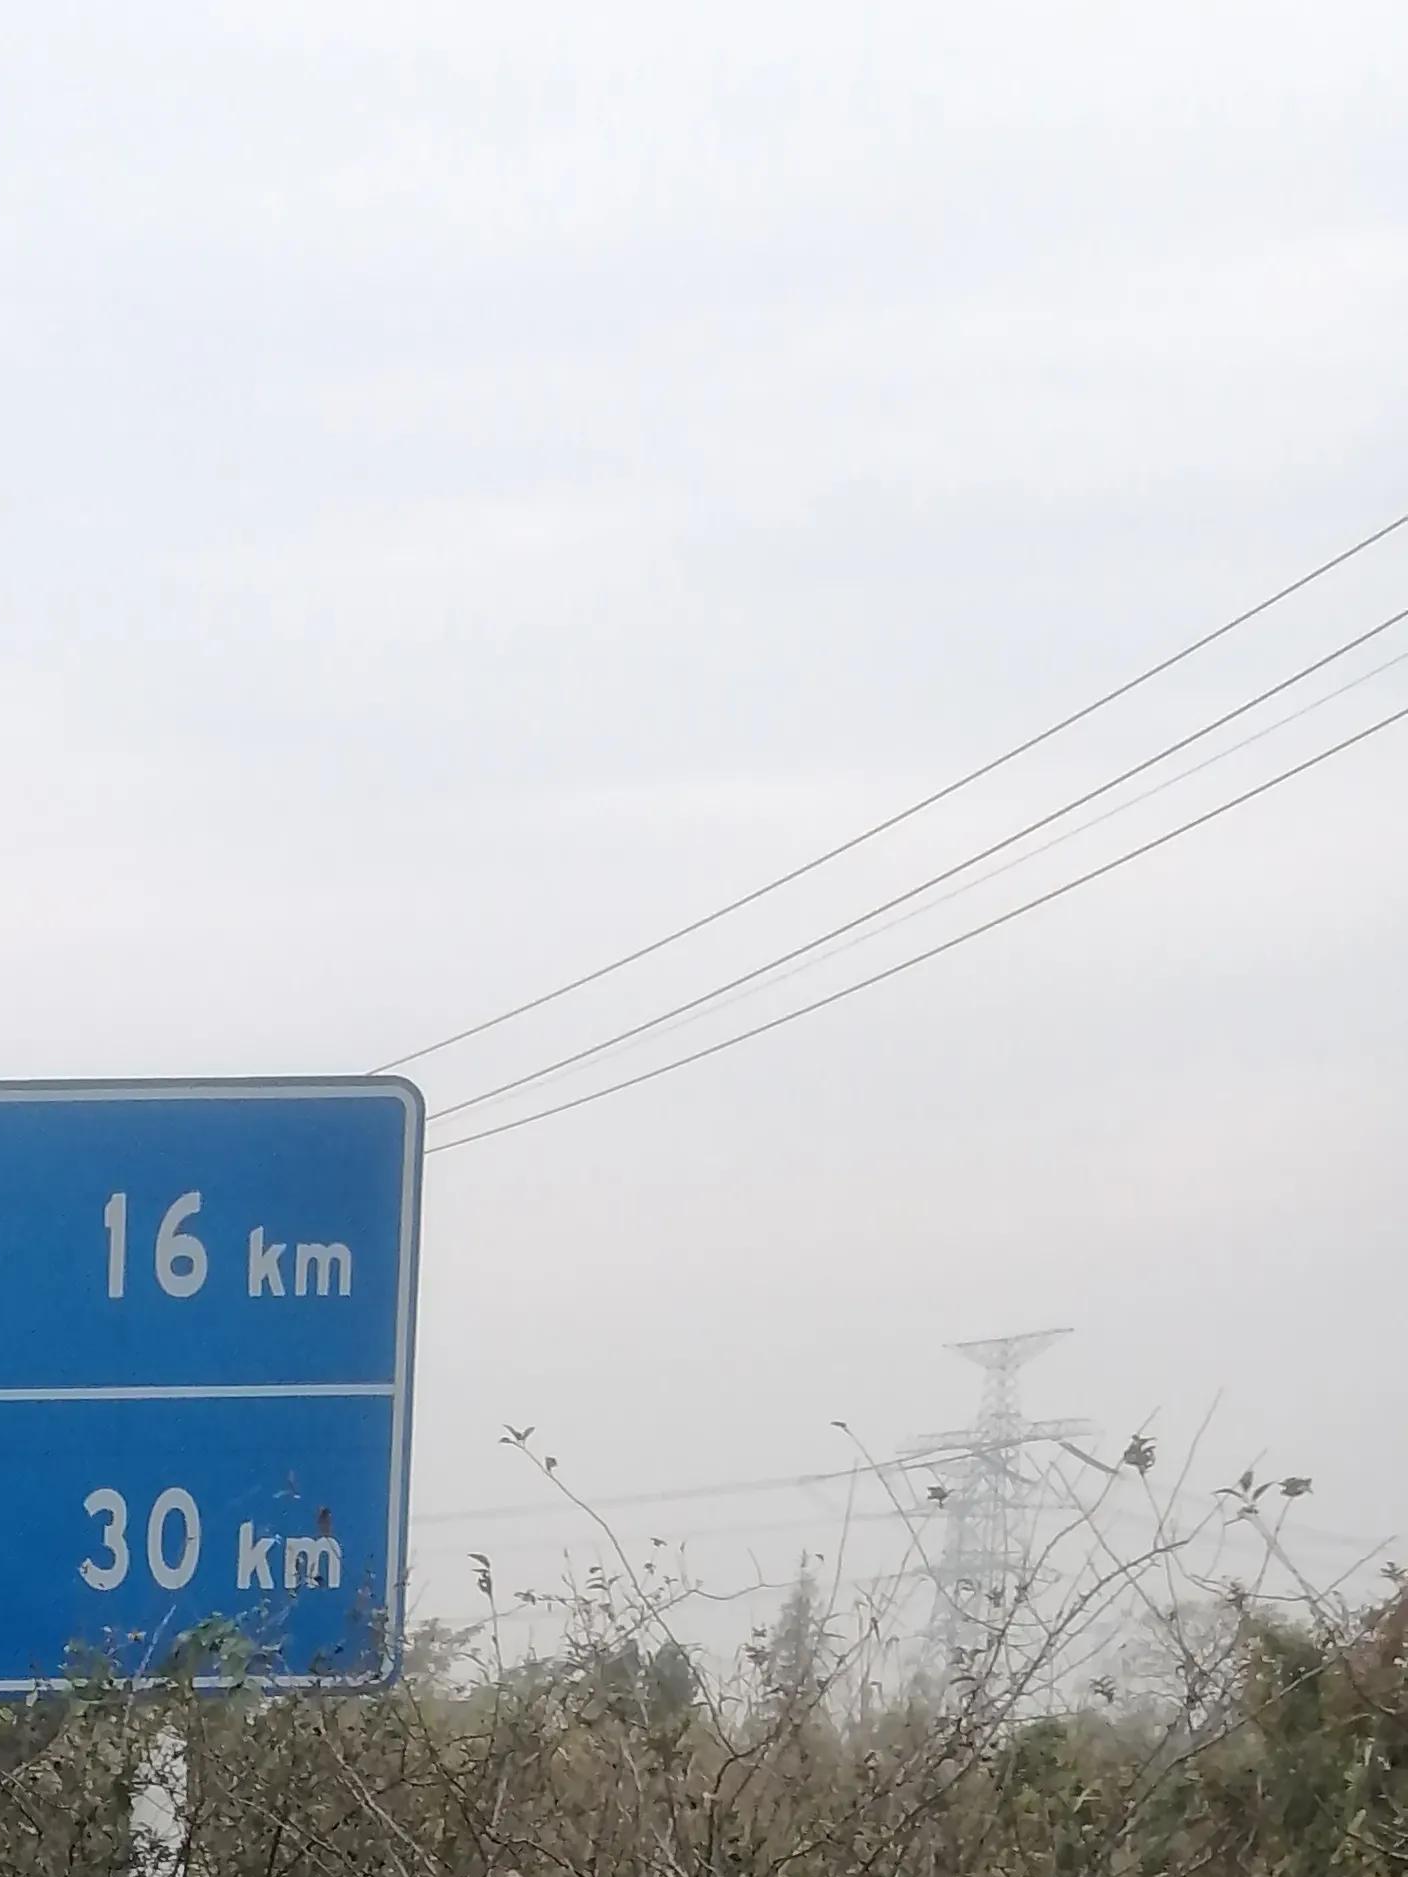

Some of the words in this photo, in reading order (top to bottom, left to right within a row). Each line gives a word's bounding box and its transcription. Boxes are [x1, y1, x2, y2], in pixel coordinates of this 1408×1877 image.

[103, 1190, 209, 1299] 16
[247, 1225, 353, 1298] km
[79, 1487, 202, 1591] 30
[236, 1519, 343, 1590] km
